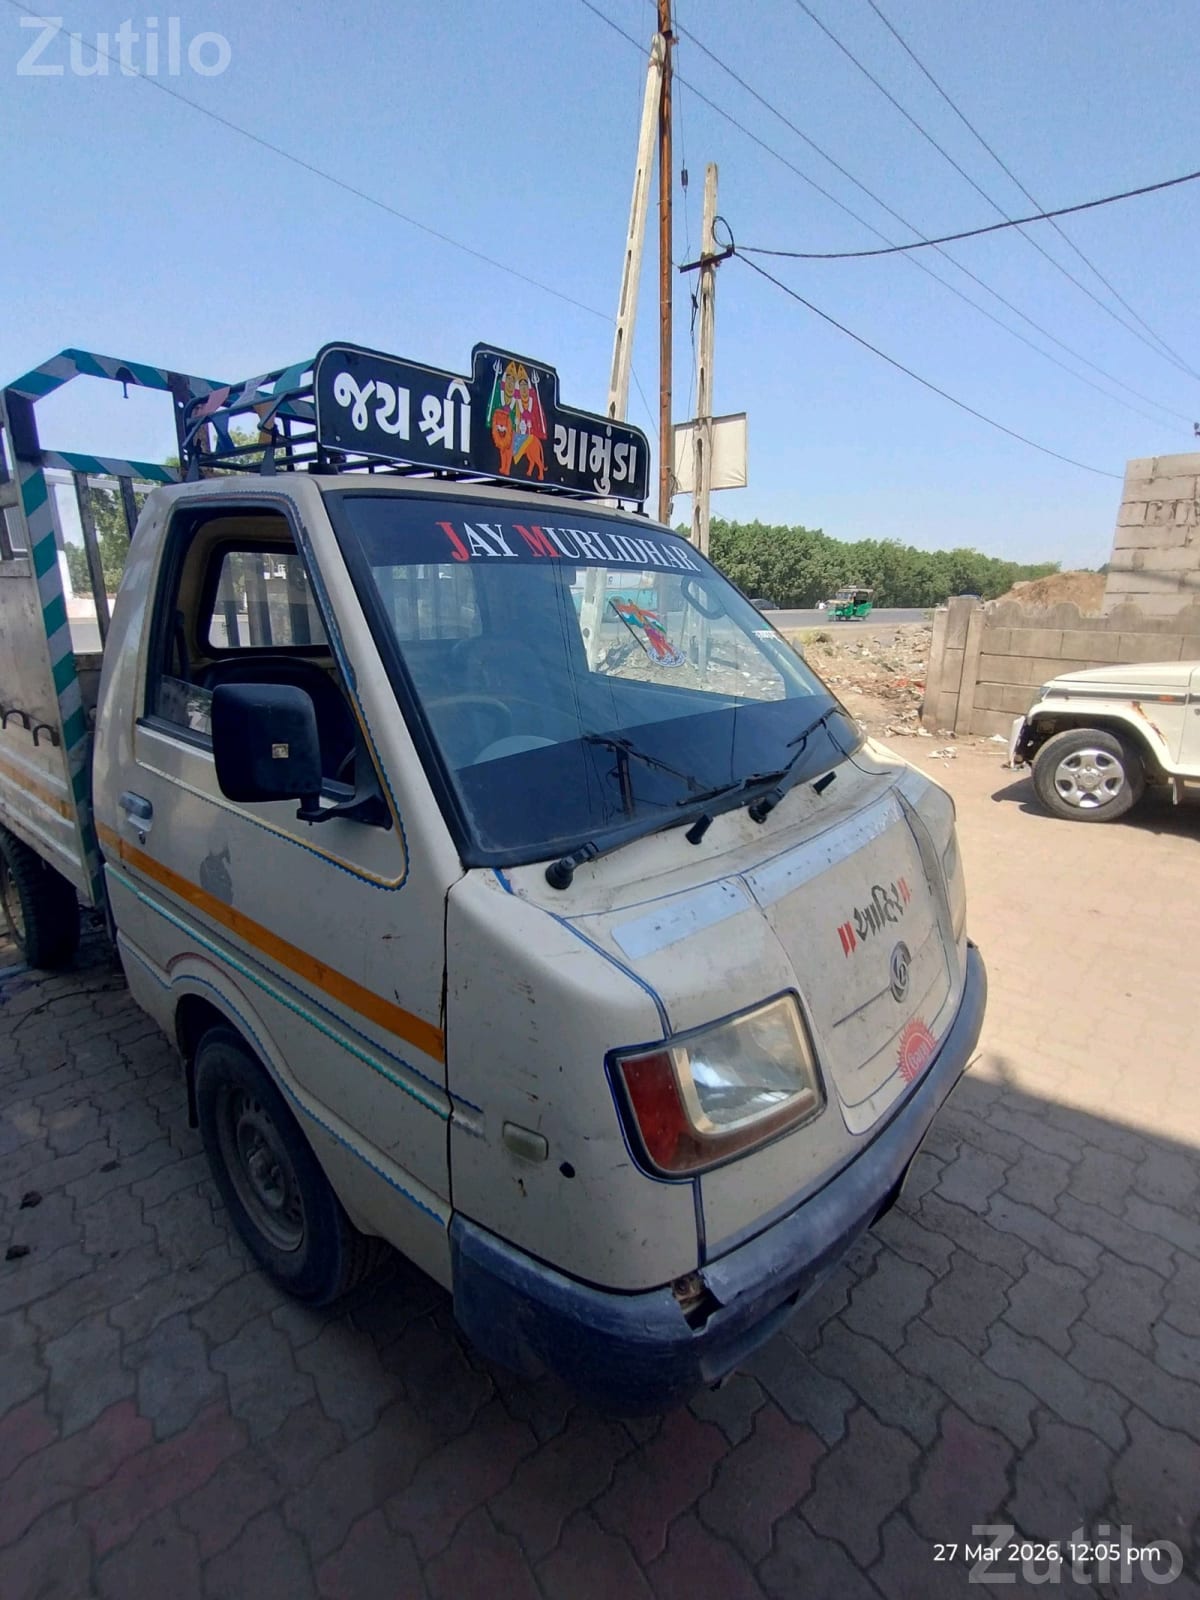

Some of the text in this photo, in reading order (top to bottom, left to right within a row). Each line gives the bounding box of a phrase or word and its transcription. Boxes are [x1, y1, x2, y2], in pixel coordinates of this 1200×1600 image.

[333, 371, 410, 440] જય
[418, 378, 471, 453] શ્રી
[435, 521, 701, 572] JAY MURLIDHAR
